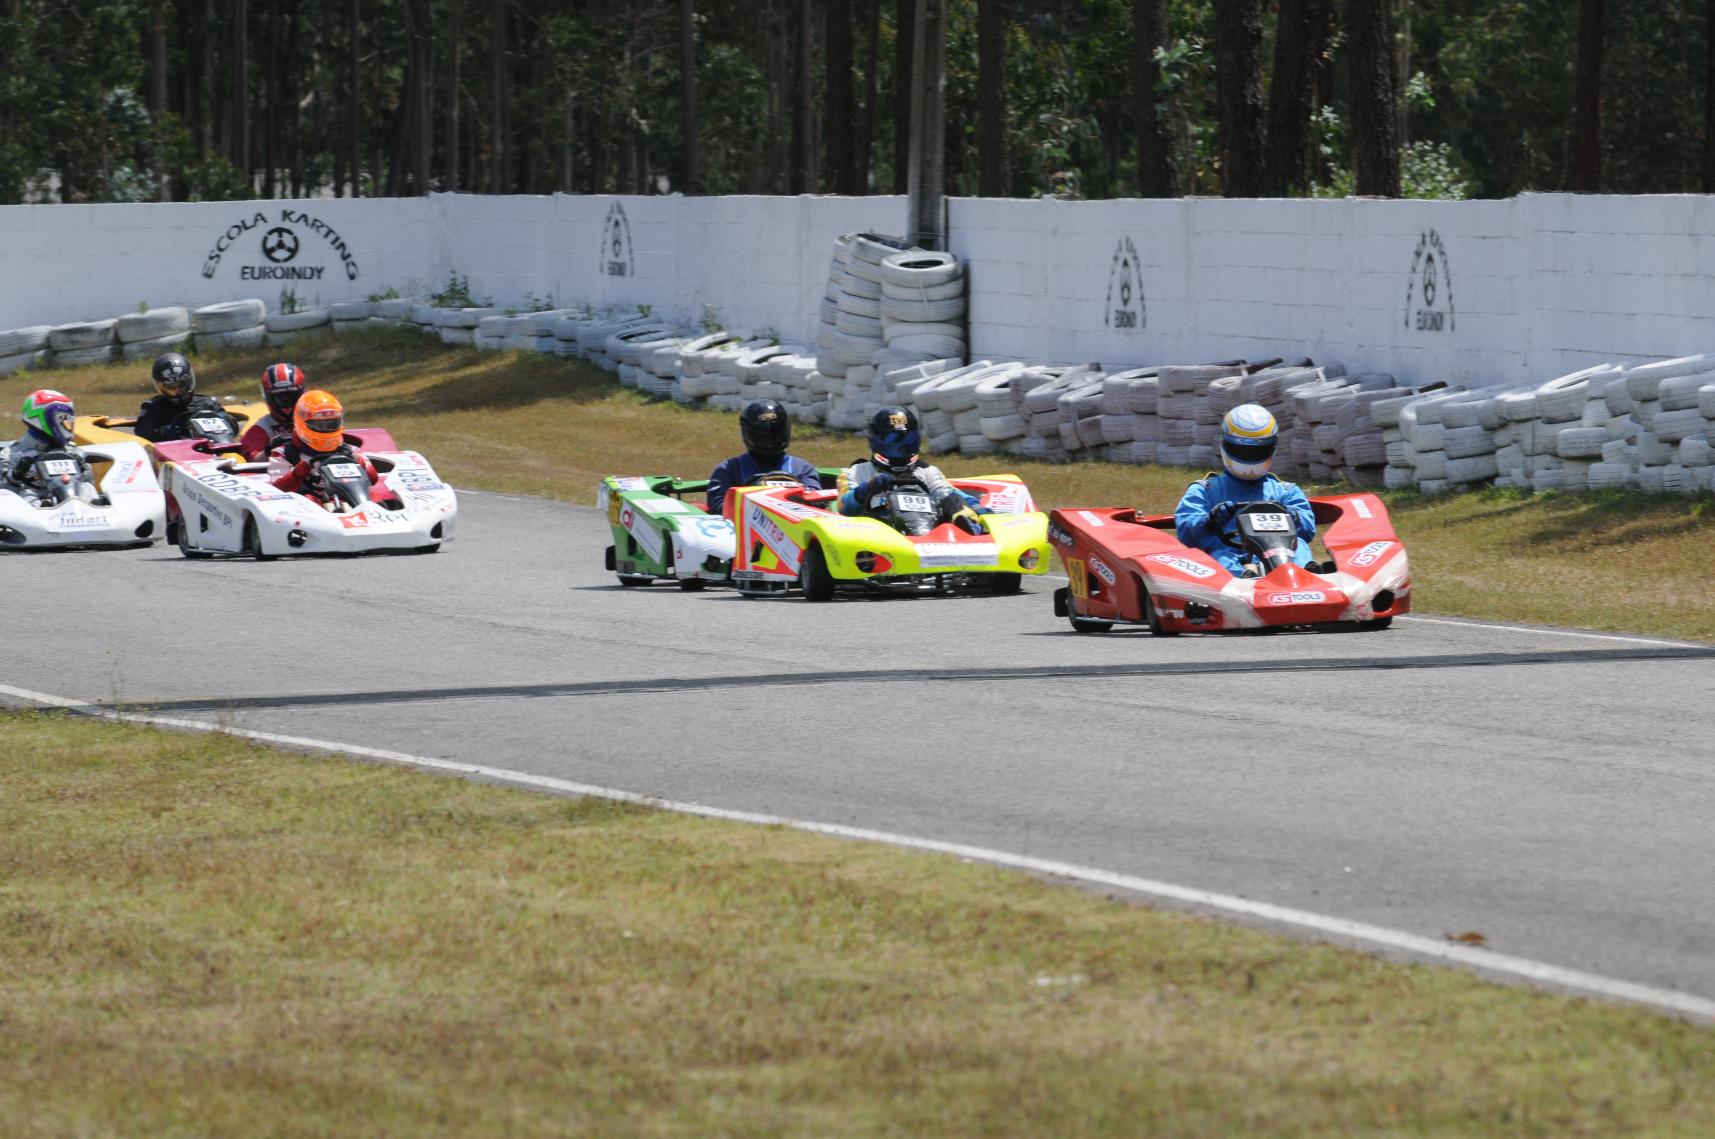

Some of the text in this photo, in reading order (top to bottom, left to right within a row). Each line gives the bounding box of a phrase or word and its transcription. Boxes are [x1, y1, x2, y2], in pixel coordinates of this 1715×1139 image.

[202, 209, 359, 281] ESCOLA KARTING
[241, 266, 325, 280] EUROINDY
[903, 495, 925, 505] 99
[753, 506, 786, 543] UNITRIP
[1255, 514, 1282, 522] 39
